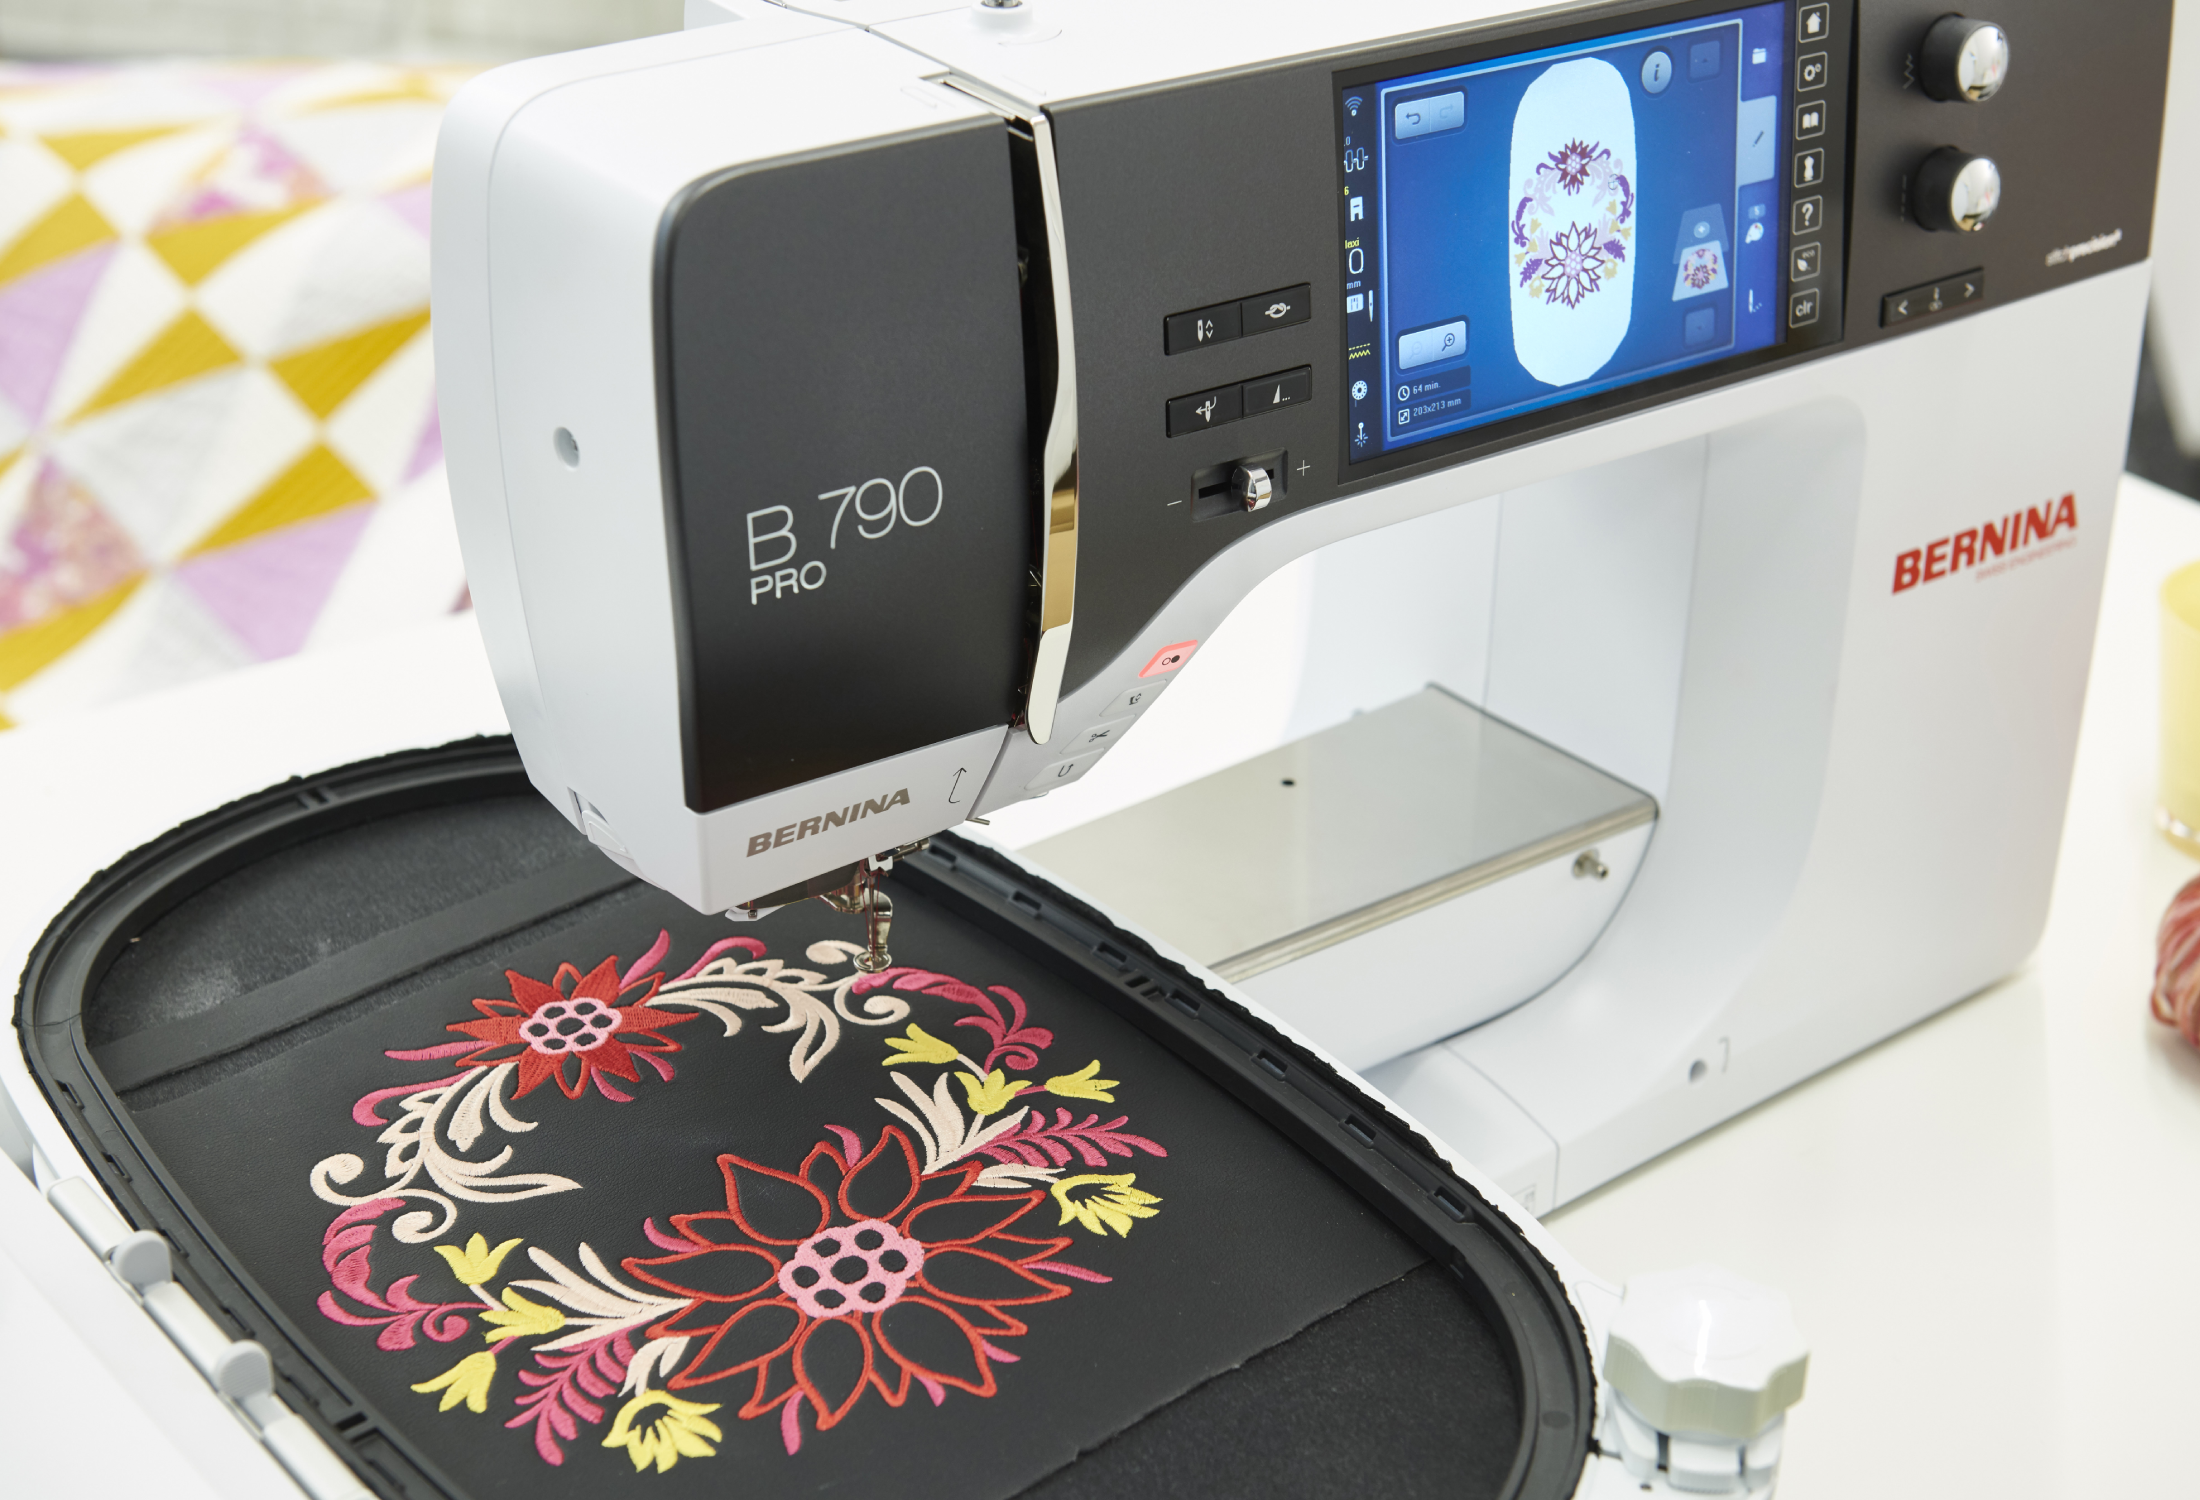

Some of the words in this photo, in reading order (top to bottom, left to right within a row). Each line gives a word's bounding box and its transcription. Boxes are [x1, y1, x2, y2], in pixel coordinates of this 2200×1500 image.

[1412, 384, 1422, 394] 64
[1424, 381, 1440, 392] min.
[1413, 400, 1446, 416] 203x213
[1447, 398, 1462, 408] mm
[746, 505, 797, 571] B
[818, 466, 944, 550] 790
[1892, 492, 2078, 596] BERNINA
[750, 560, 827, 605] PRO
[746, 788, 911, 858] BERNINA
